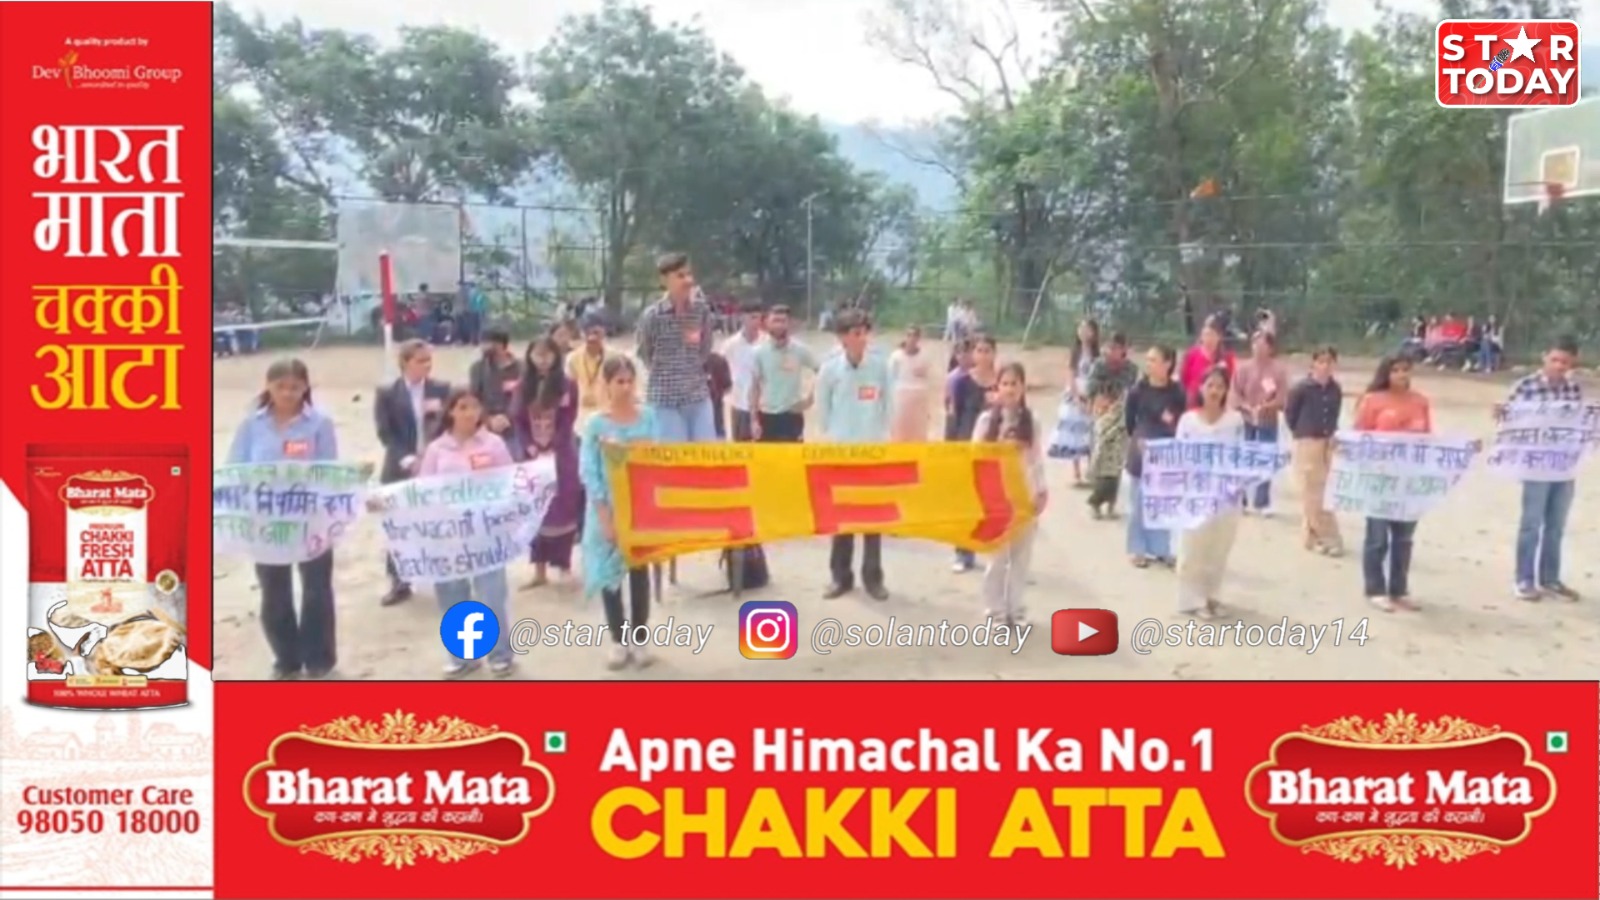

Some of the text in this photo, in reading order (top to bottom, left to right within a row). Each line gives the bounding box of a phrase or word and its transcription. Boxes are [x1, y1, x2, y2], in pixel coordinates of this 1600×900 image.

[66, 486, 148, 499] Bharat Mata
[80, 530, 134, 543] CHAKKI
[80, 544, 134, 558] FRESH
[81, 559, 134, 577] ATTA
[76, 689, 107, 698] WHOLE
[109, 689, 138, 698] WHEAT
[140, 689, 161, 698] ATTA
